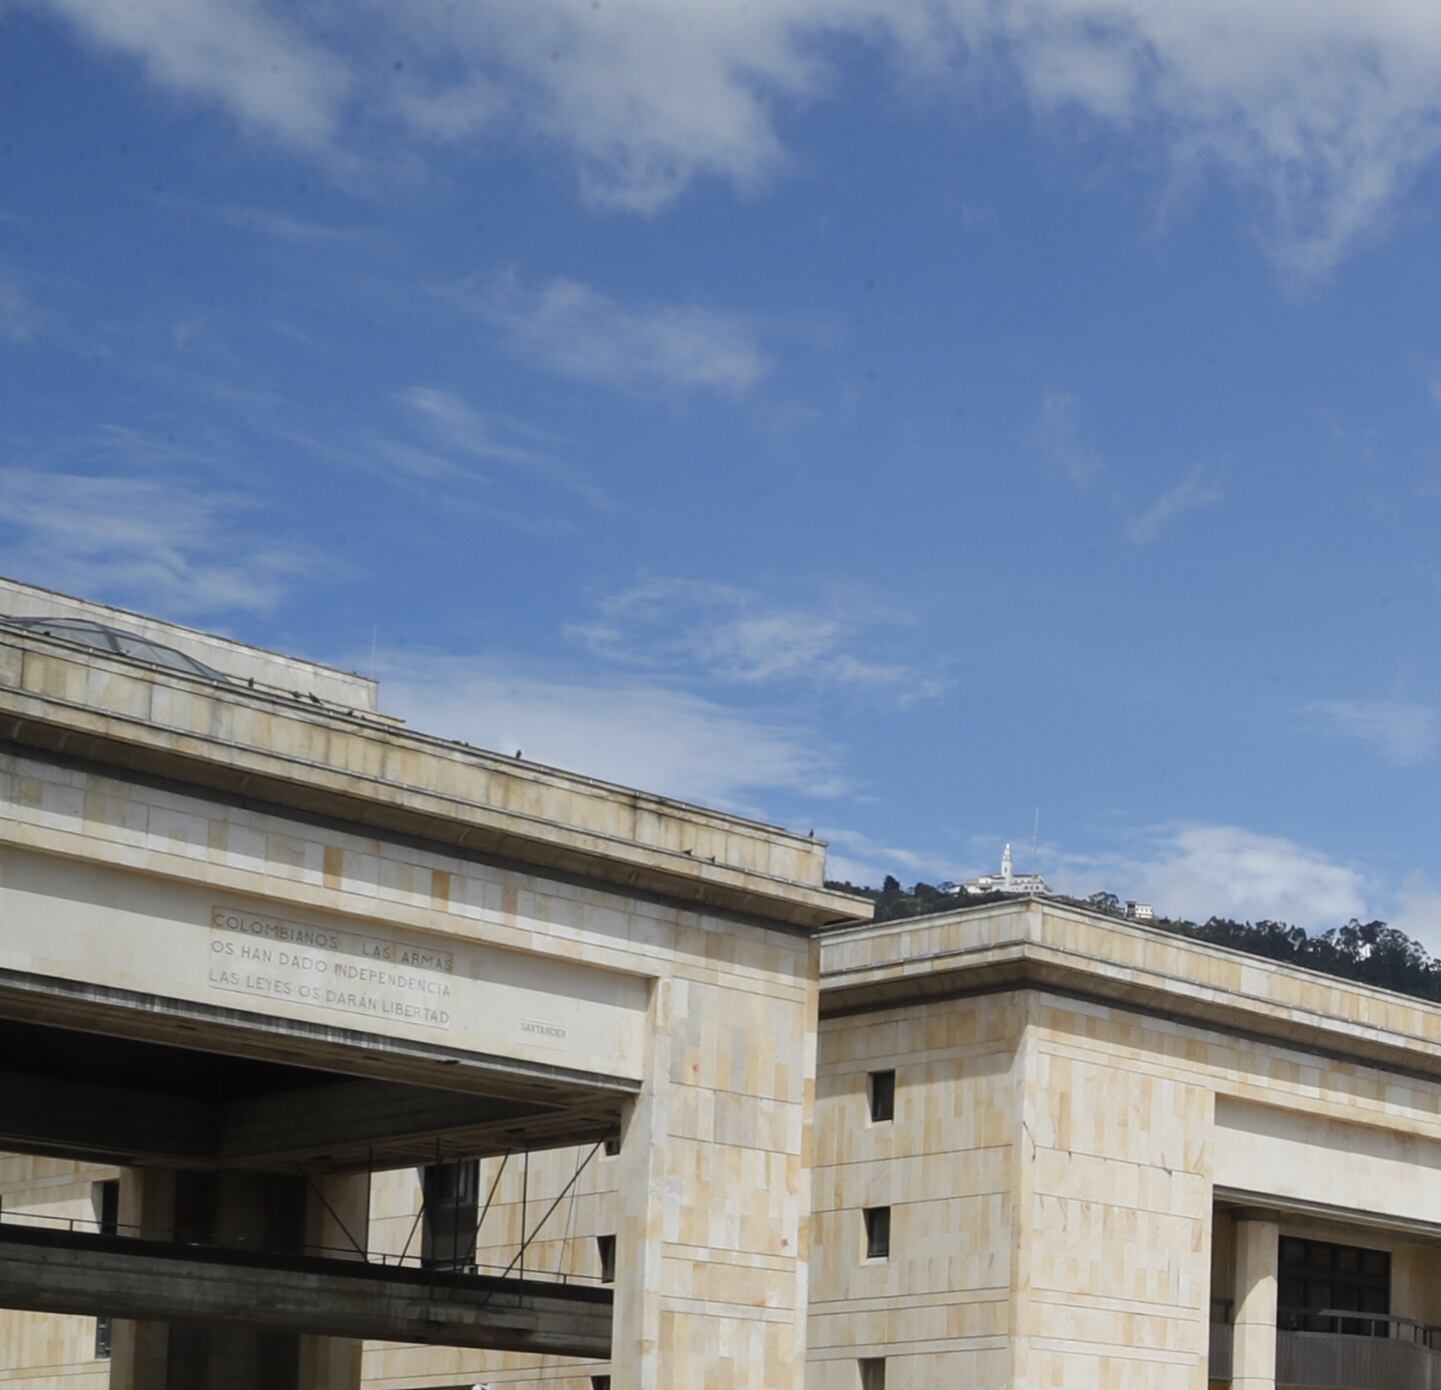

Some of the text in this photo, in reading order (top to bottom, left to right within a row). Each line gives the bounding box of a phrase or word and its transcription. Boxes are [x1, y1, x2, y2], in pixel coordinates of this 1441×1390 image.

[211, 940, 451, 997] OS HAN DADO INDEPENDENCIA
[212, 913, 453, 972] COLOMBIANOS LAS ARMAS
[208, 968, 240, 986] LAS
[246, 974, 292, 995] LEYES
[297, 984, 321, 1001] OS
[381, 1000, 450, 1024] LIBERTAD
